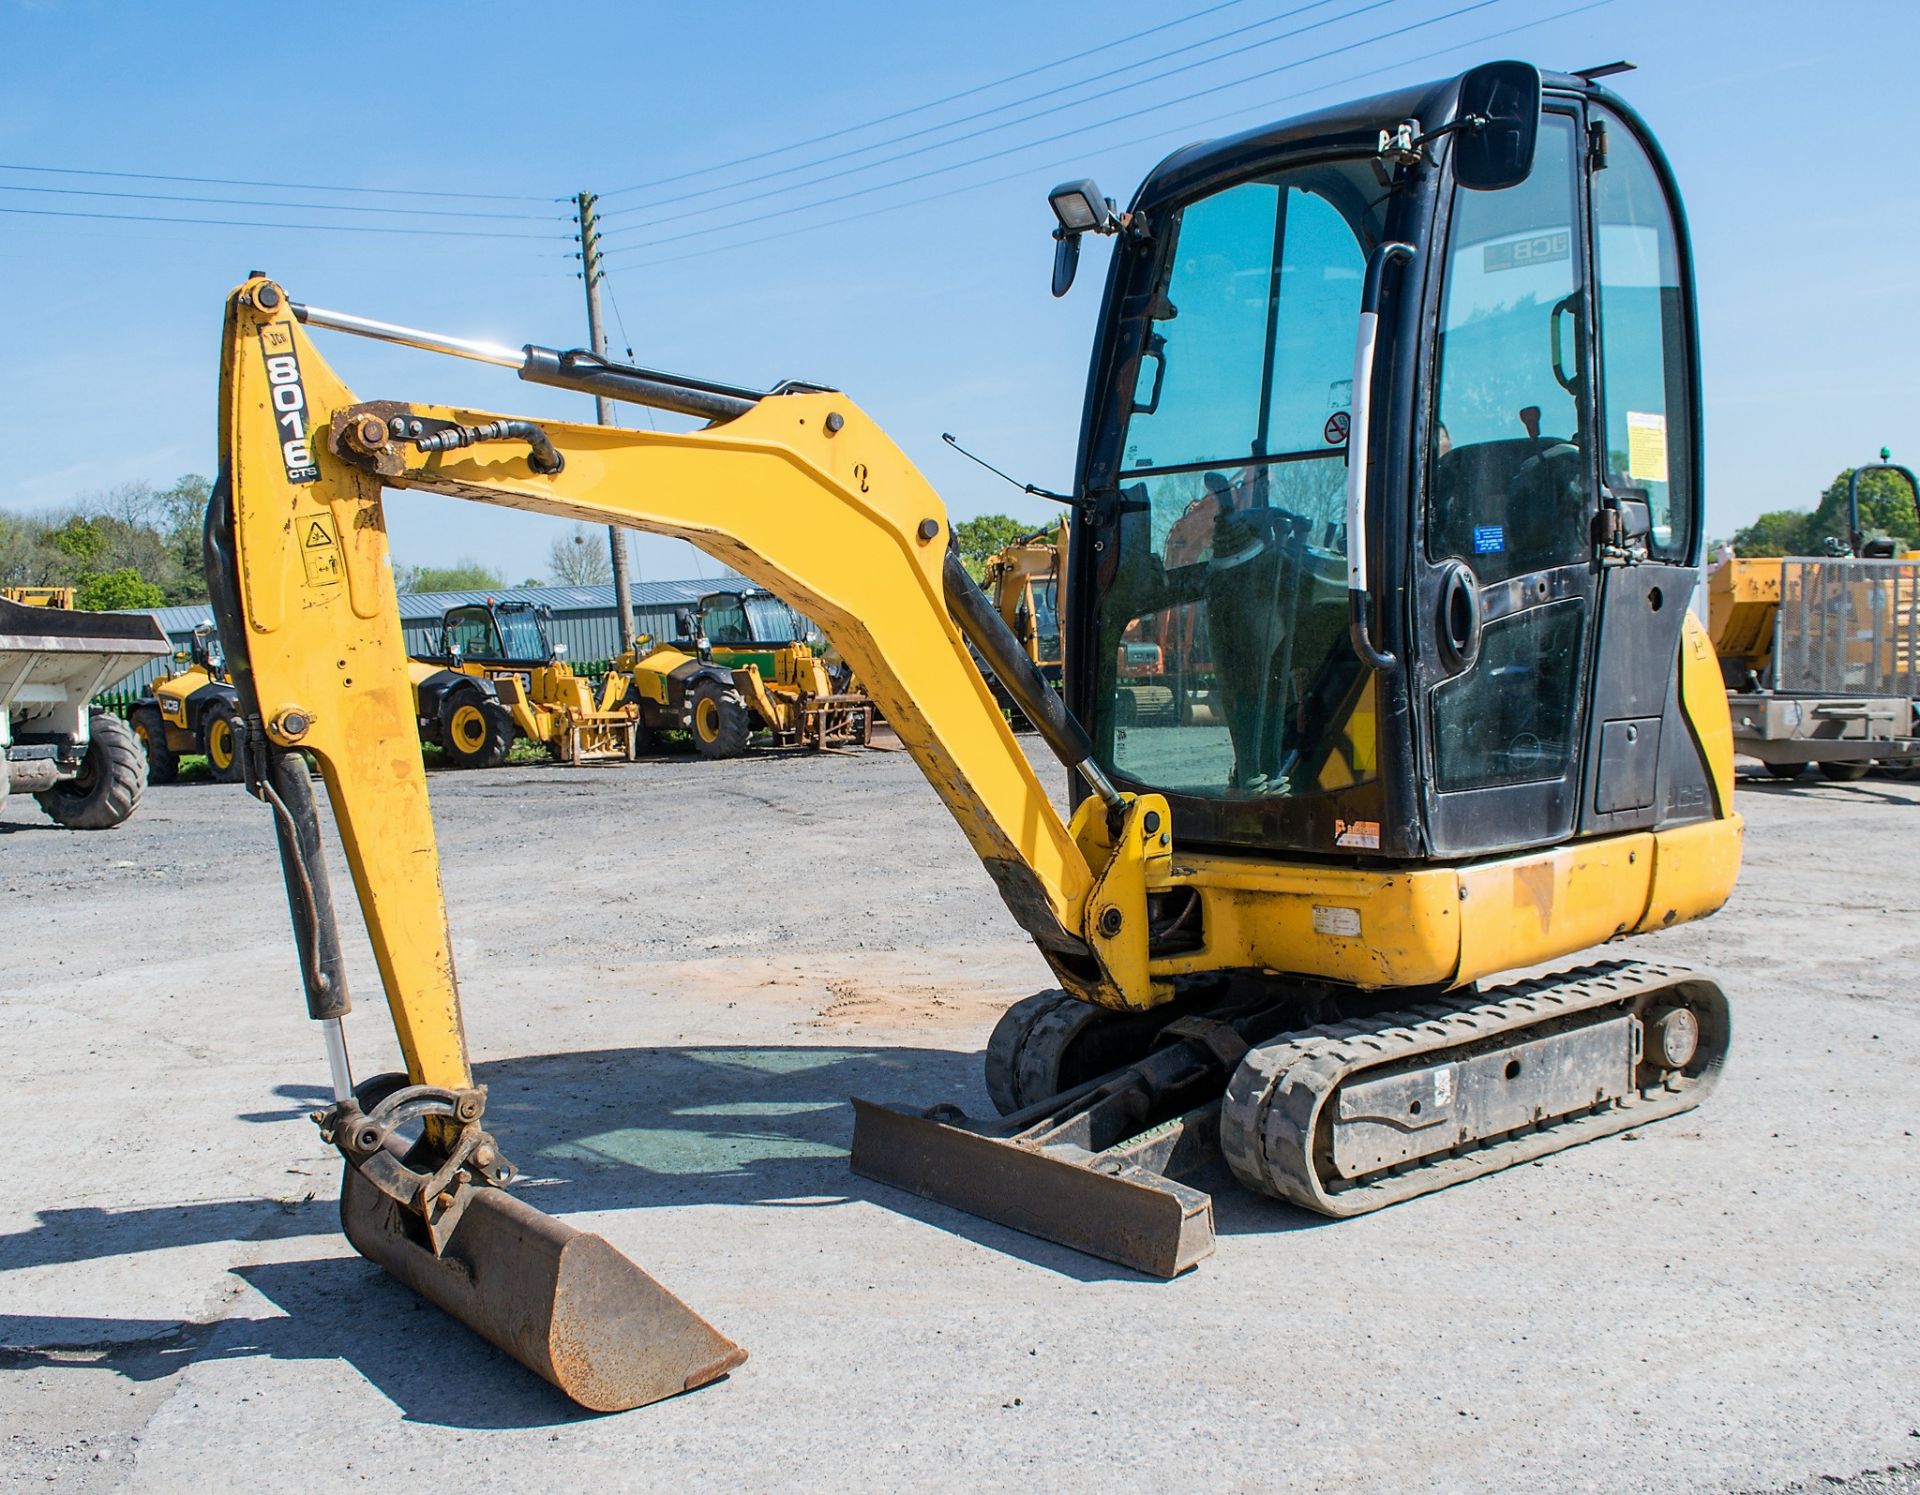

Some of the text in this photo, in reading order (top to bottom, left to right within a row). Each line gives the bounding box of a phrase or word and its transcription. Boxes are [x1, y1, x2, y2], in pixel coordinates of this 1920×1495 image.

[270, 332, 287, 346] JCB
[266, 356, 315, 468] 8016
[288, 467, 317, 478] CTS
[163, 699, 178, 711] JCB
